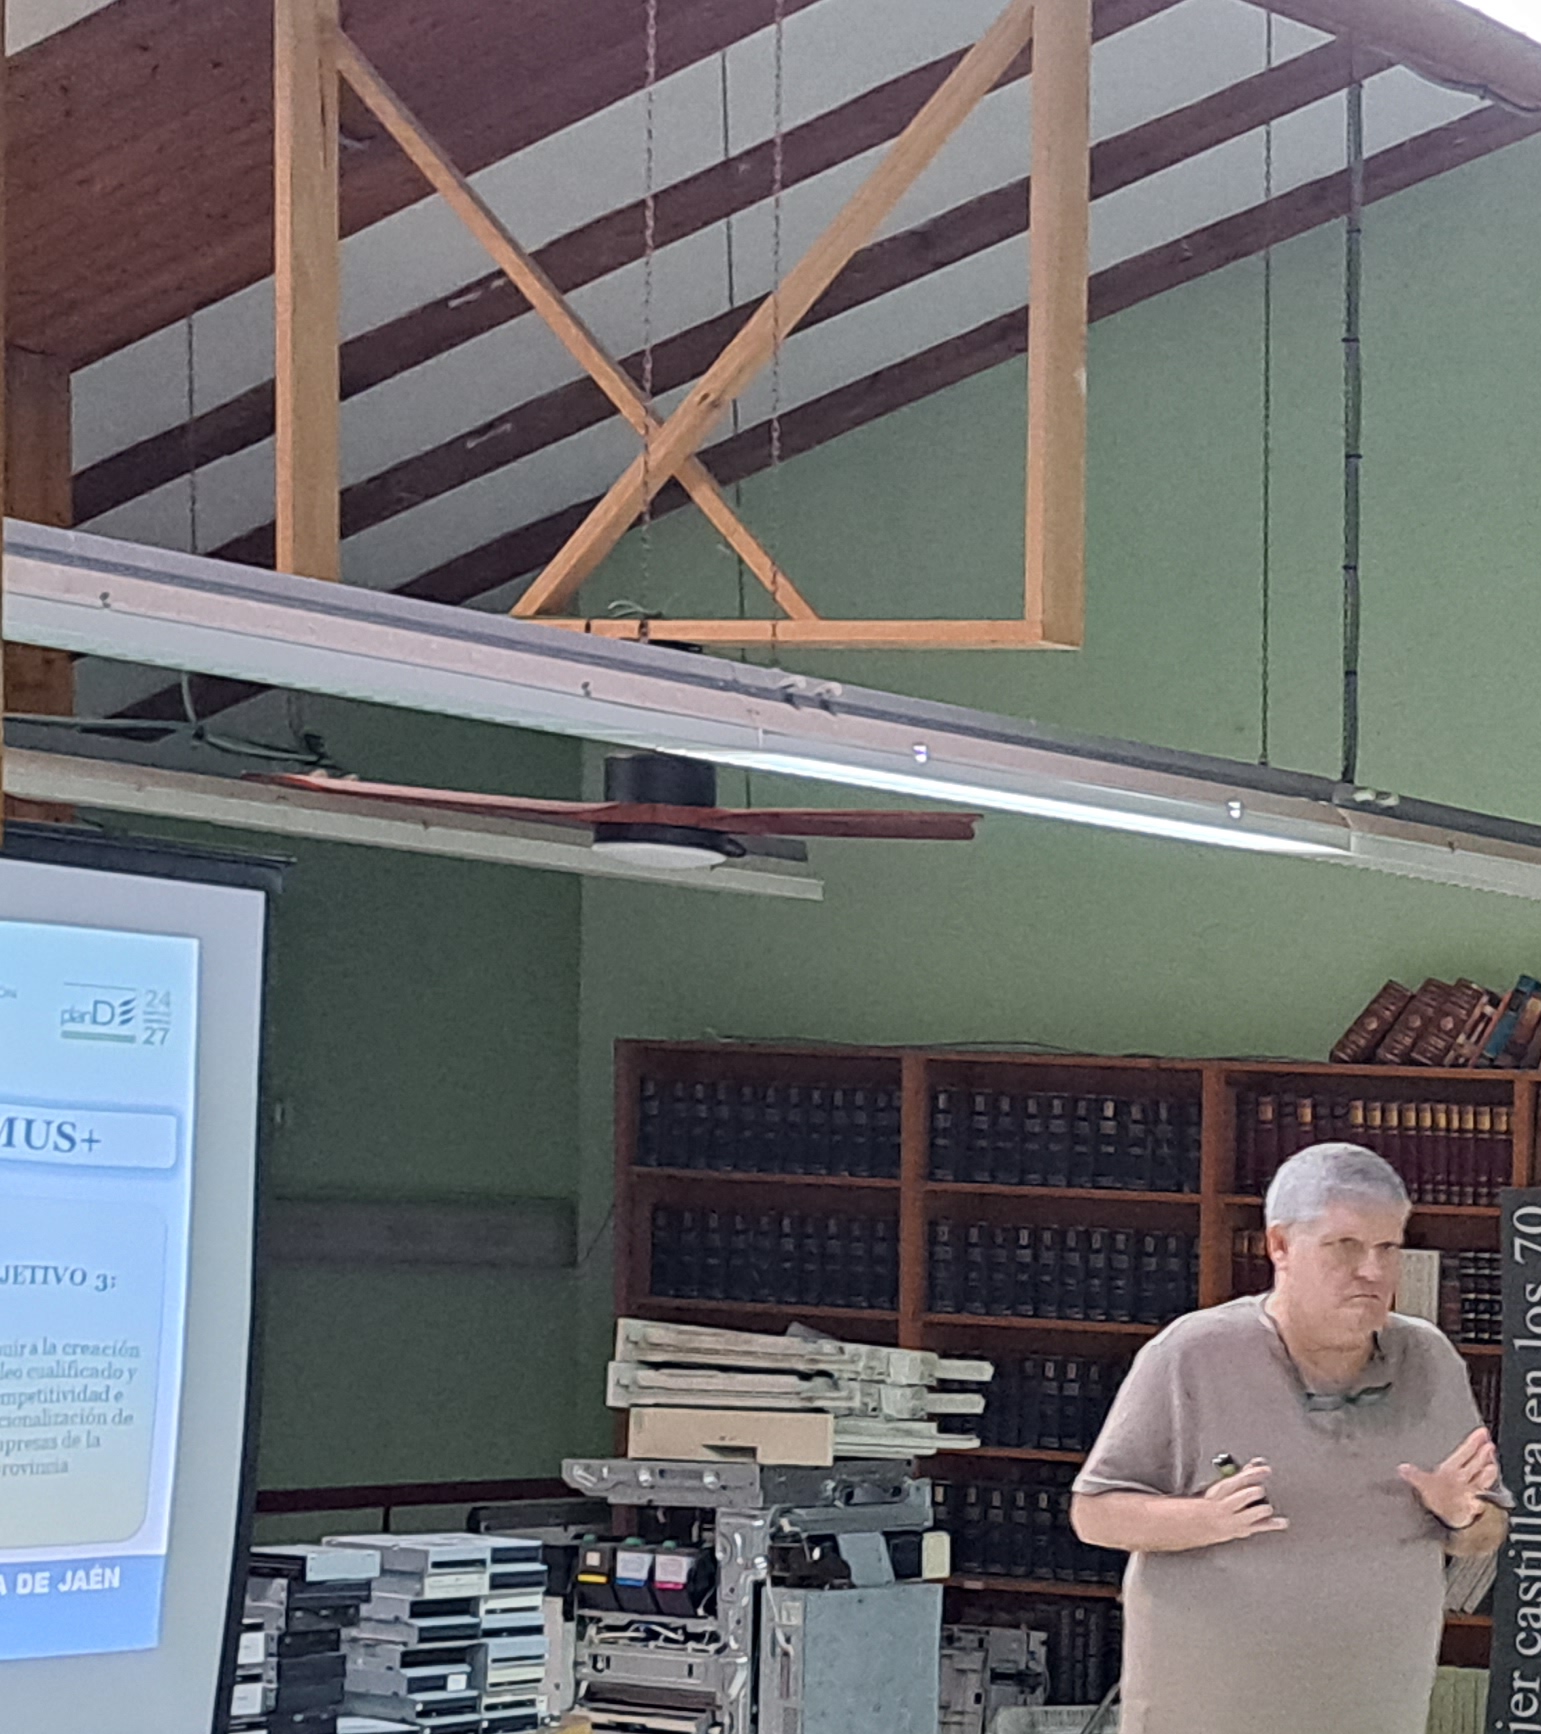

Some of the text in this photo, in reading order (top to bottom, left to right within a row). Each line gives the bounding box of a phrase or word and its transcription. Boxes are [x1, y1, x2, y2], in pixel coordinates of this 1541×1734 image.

[144, 989, 172, 1009] 24
[142, 1025, 171, 1047] 27
[42, 1335, 57, 1356] la
[62, 1341, 141, 1358] creación
[26, 1360, 124, 1380] cualificado
[127, 1366, 138, 1385] y
[114, 1390, 124, 1404] e
[111, 1407, 135, 1426] de
[61, 1430, 82, 1449] de
[86, 1429, 101, 1449] la
[0, 1459, 69, 1477] rovincia
[16, 1570, 51, 1596] DE
[57, 1563, 121, 1593] JAÉN
